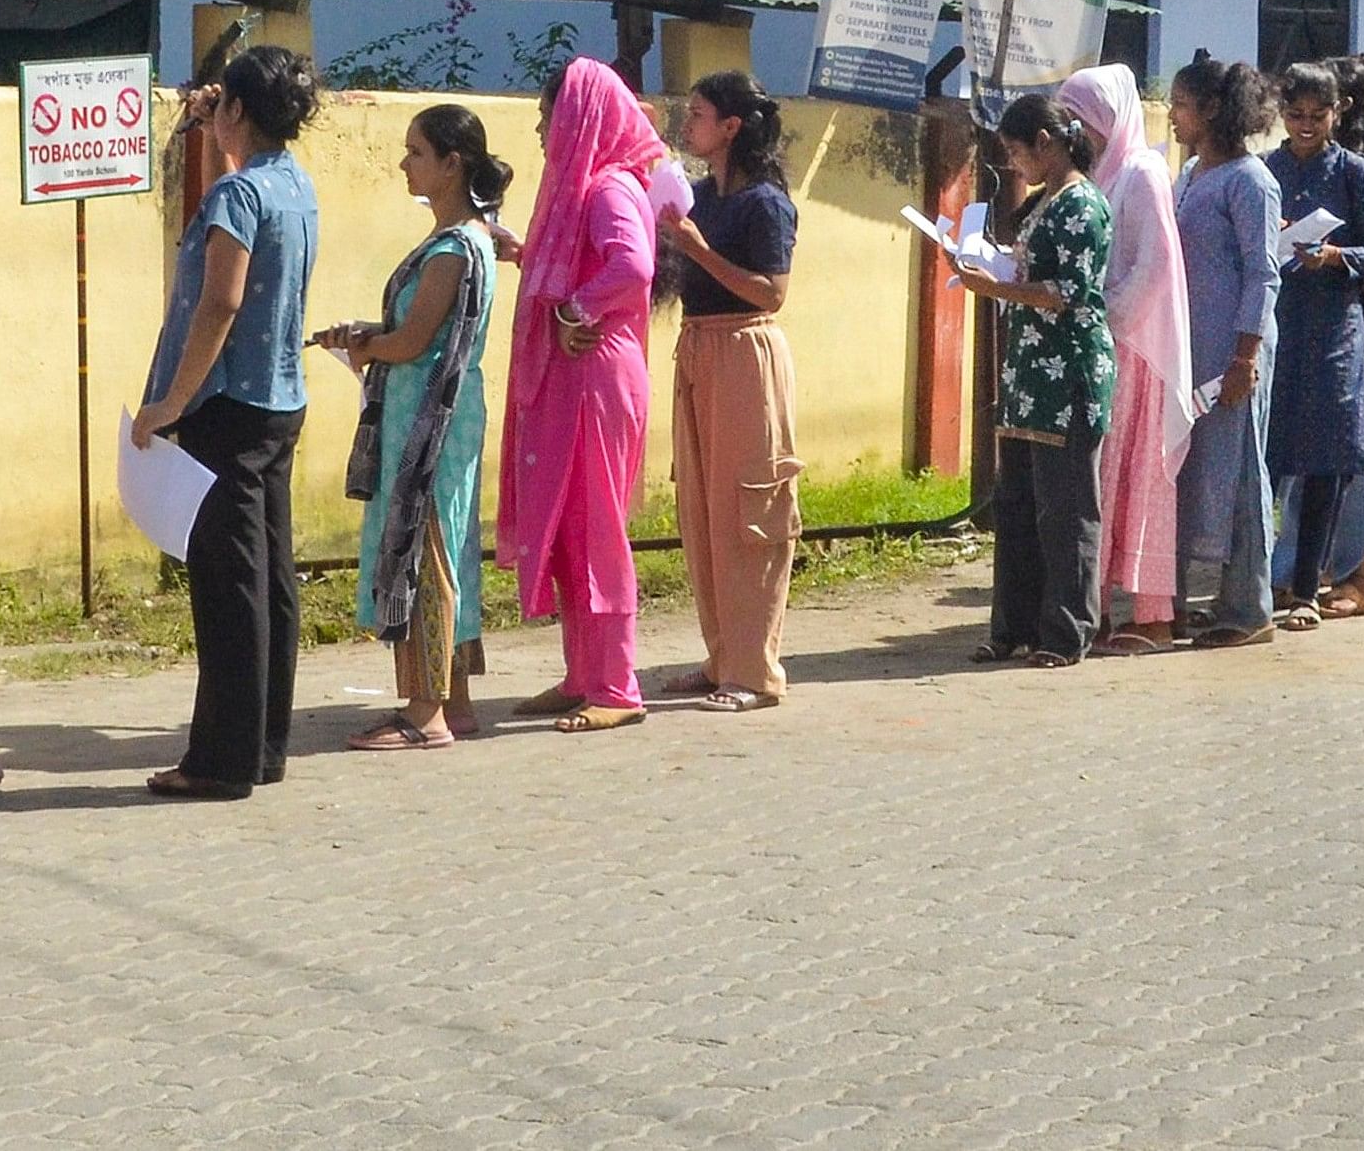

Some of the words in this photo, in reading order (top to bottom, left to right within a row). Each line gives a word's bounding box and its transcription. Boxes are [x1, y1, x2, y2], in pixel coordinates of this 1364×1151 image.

[849, 1, 874, 12] FROM
[891, 6, 935, 21] ONWARDS
[846, 17, 889, 31] SEPARATE
[891, 23, 928, 37] HOSTELS
[1028, 17, 1054, 28] FROM
[845, 27, 862, 37] FOR
[887, 34, 906, 45] AND
[71, 105, 108, 130] NO
[29, 140, 104, 166] TOBACCO
[108, 136, 147, 158] ZONE
